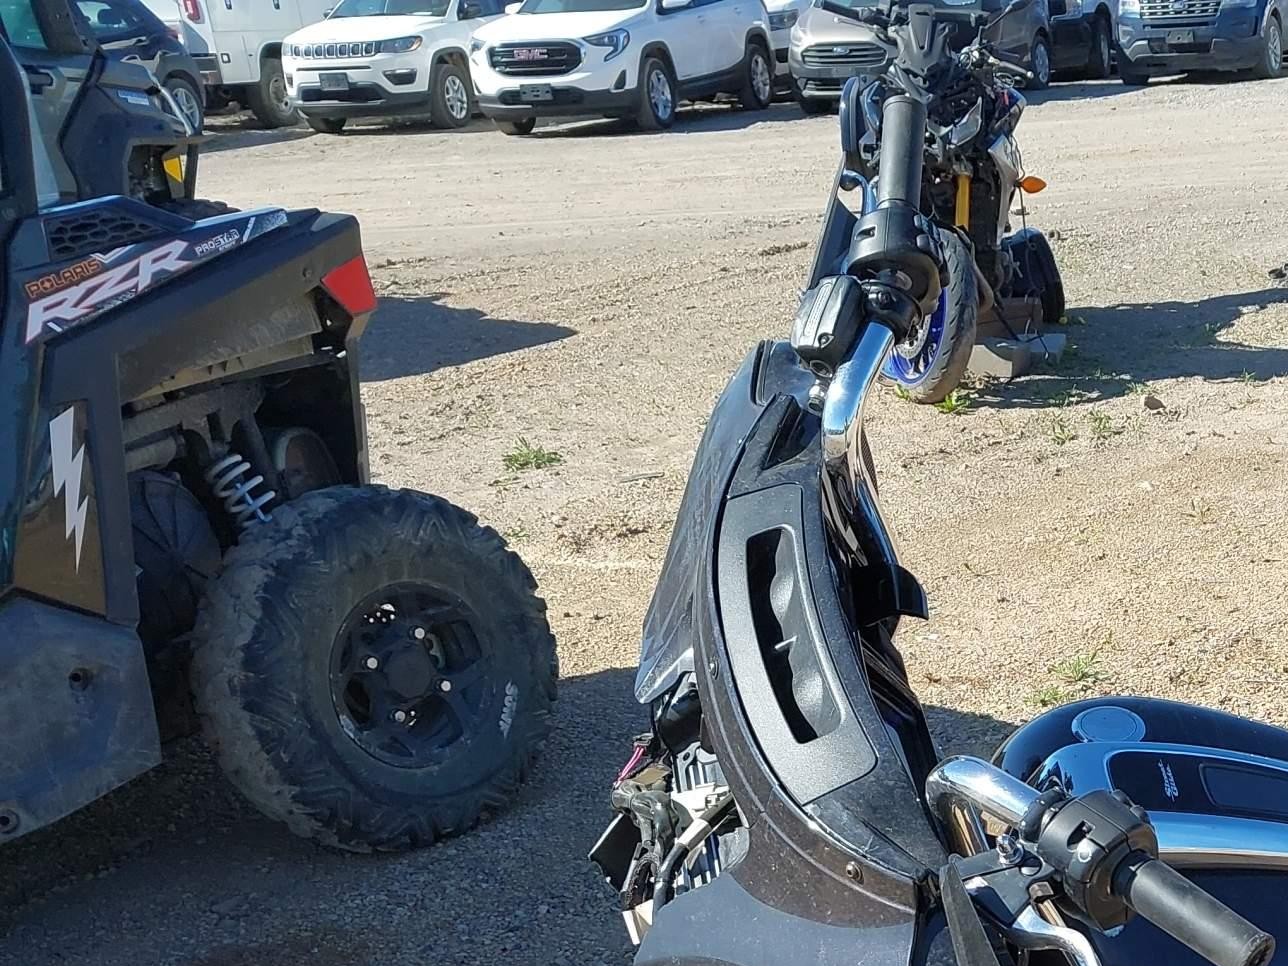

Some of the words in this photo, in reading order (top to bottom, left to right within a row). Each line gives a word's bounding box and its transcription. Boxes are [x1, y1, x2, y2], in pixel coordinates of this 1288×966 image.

[513, 48, 548, 60] GMC
[25, 258, 101, 298] POLARIS
[25, 239, 192, 345] RZR
